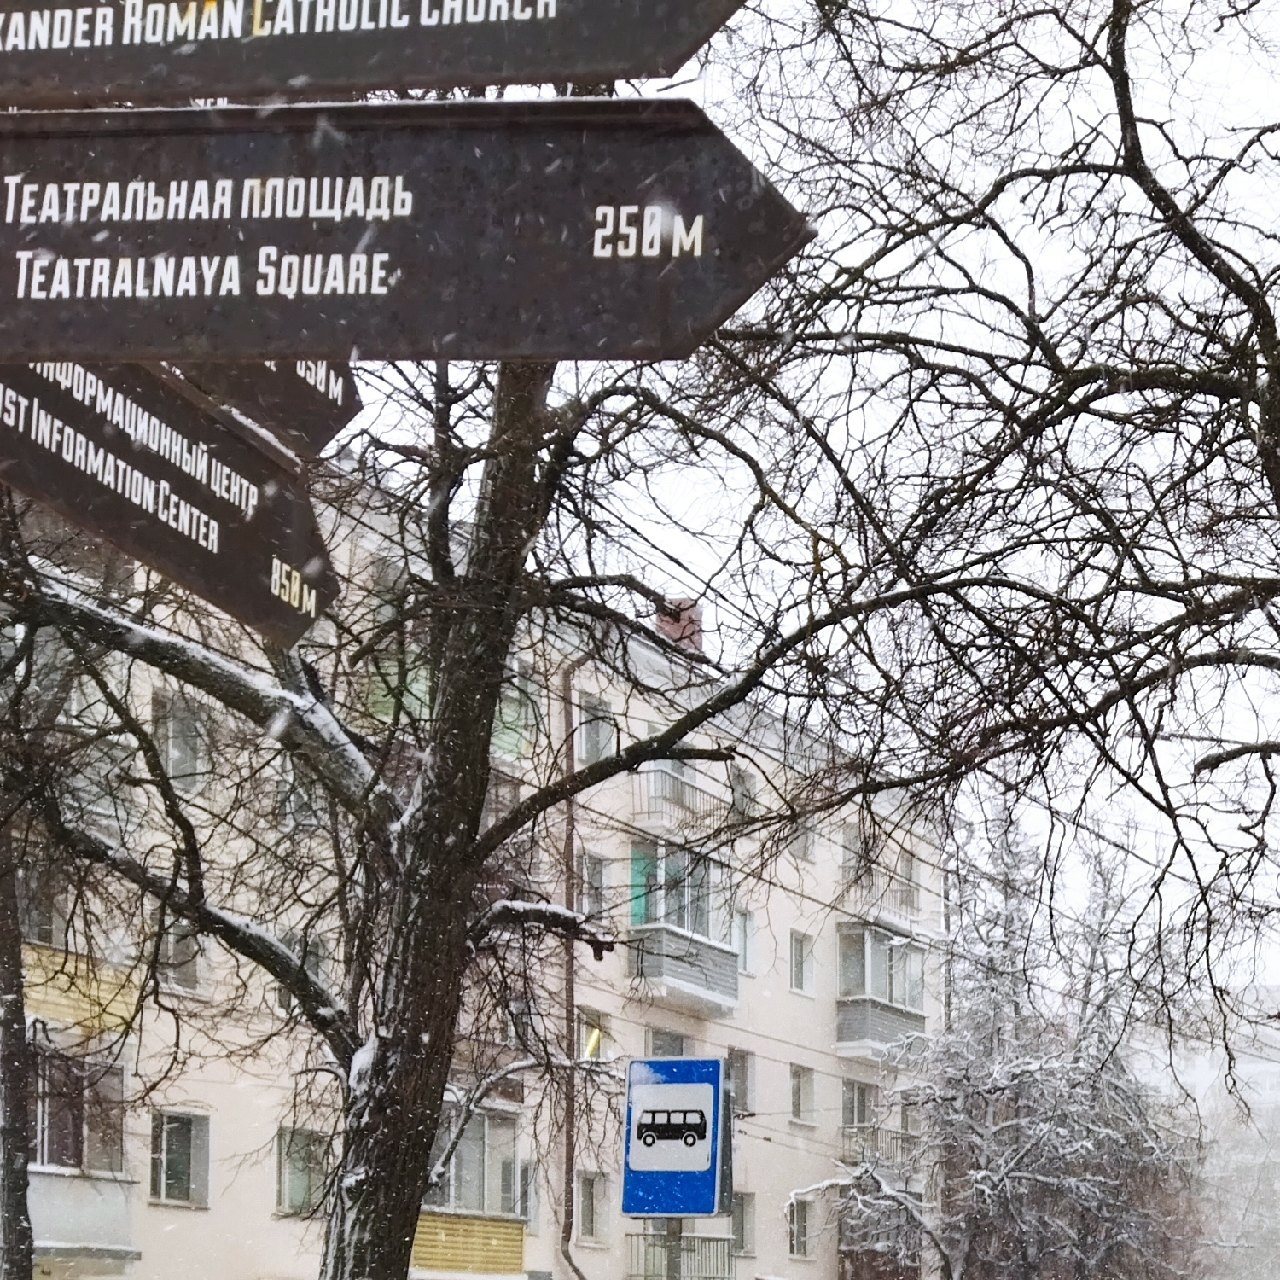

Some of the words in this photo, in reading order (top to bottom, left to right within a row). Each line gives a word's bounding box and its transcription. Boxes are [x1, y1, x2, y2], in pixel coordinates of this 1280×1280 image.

[122, 0, 244, 45] ROMAN
[252, 0, 410, 37] CATHOLIC
[4, 175, 233, 223] ТЕАТРАЛЬНАЯ
[241, 175, 413, 222] ПЛОЩАДЬ
[593, 205, 662, 257] 250
[16, 250, 241, 299] TEATRALNAYA
[256, 246, 390, 299] SQUARE
[29, 361, 208, 485] НФОРМАЦИОННЫЙ
[211, 458, 259, 517] ЦЕНТР
[31, 397, 155, 514] INFORMATION
[158, 479, 219, 554] CENTER
[270, 557, 301, 608] 850
